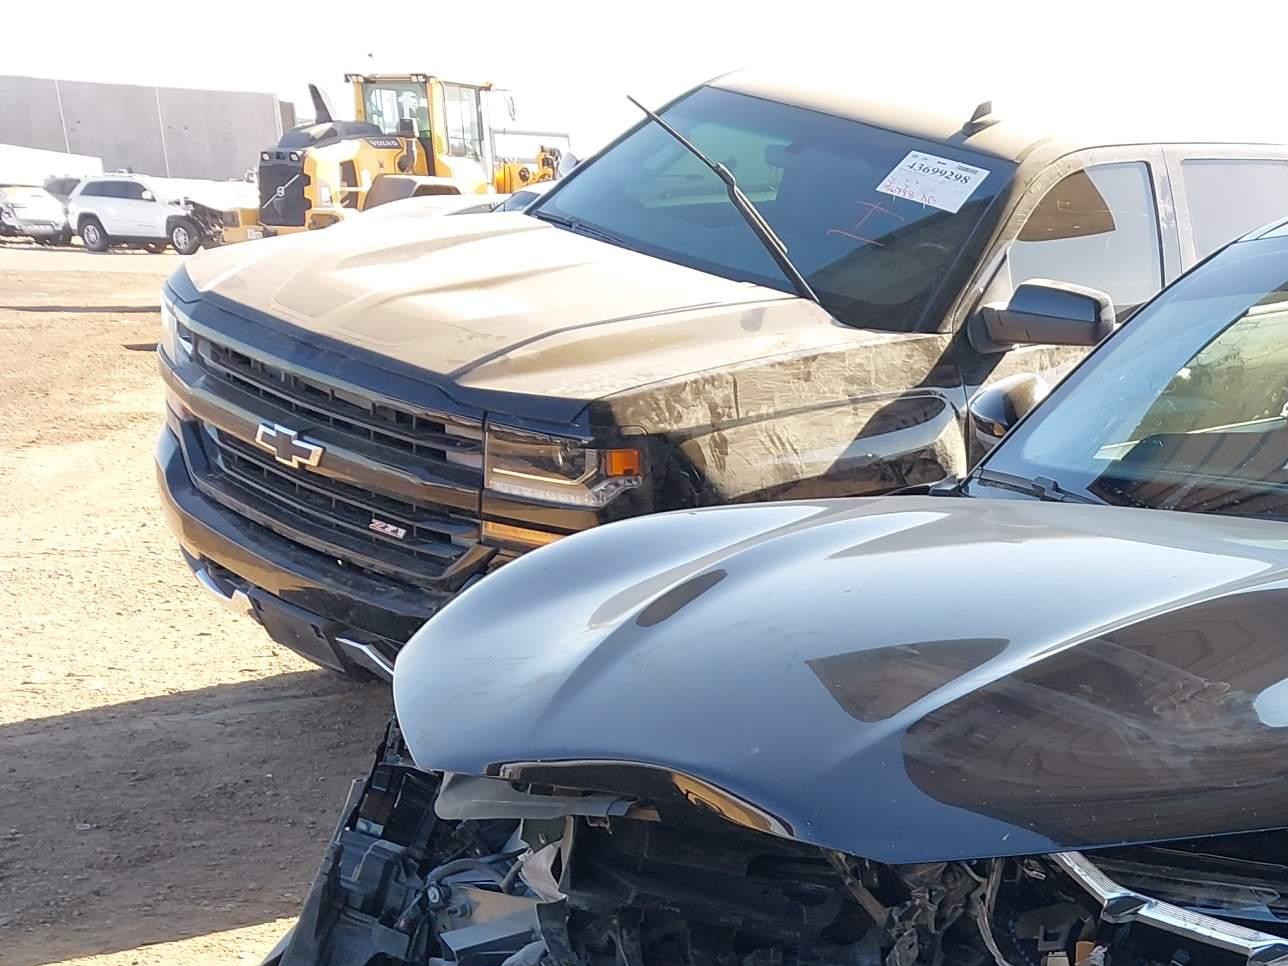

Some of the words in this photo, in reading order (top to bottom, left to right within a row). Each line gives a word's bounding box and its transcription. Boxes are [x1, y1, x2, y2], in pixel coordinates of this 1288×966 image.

[370, 139, 399, 147] VOLVO
[906, 160, 972, 185] 43699298
[368, 518, 407, 540] Z71
